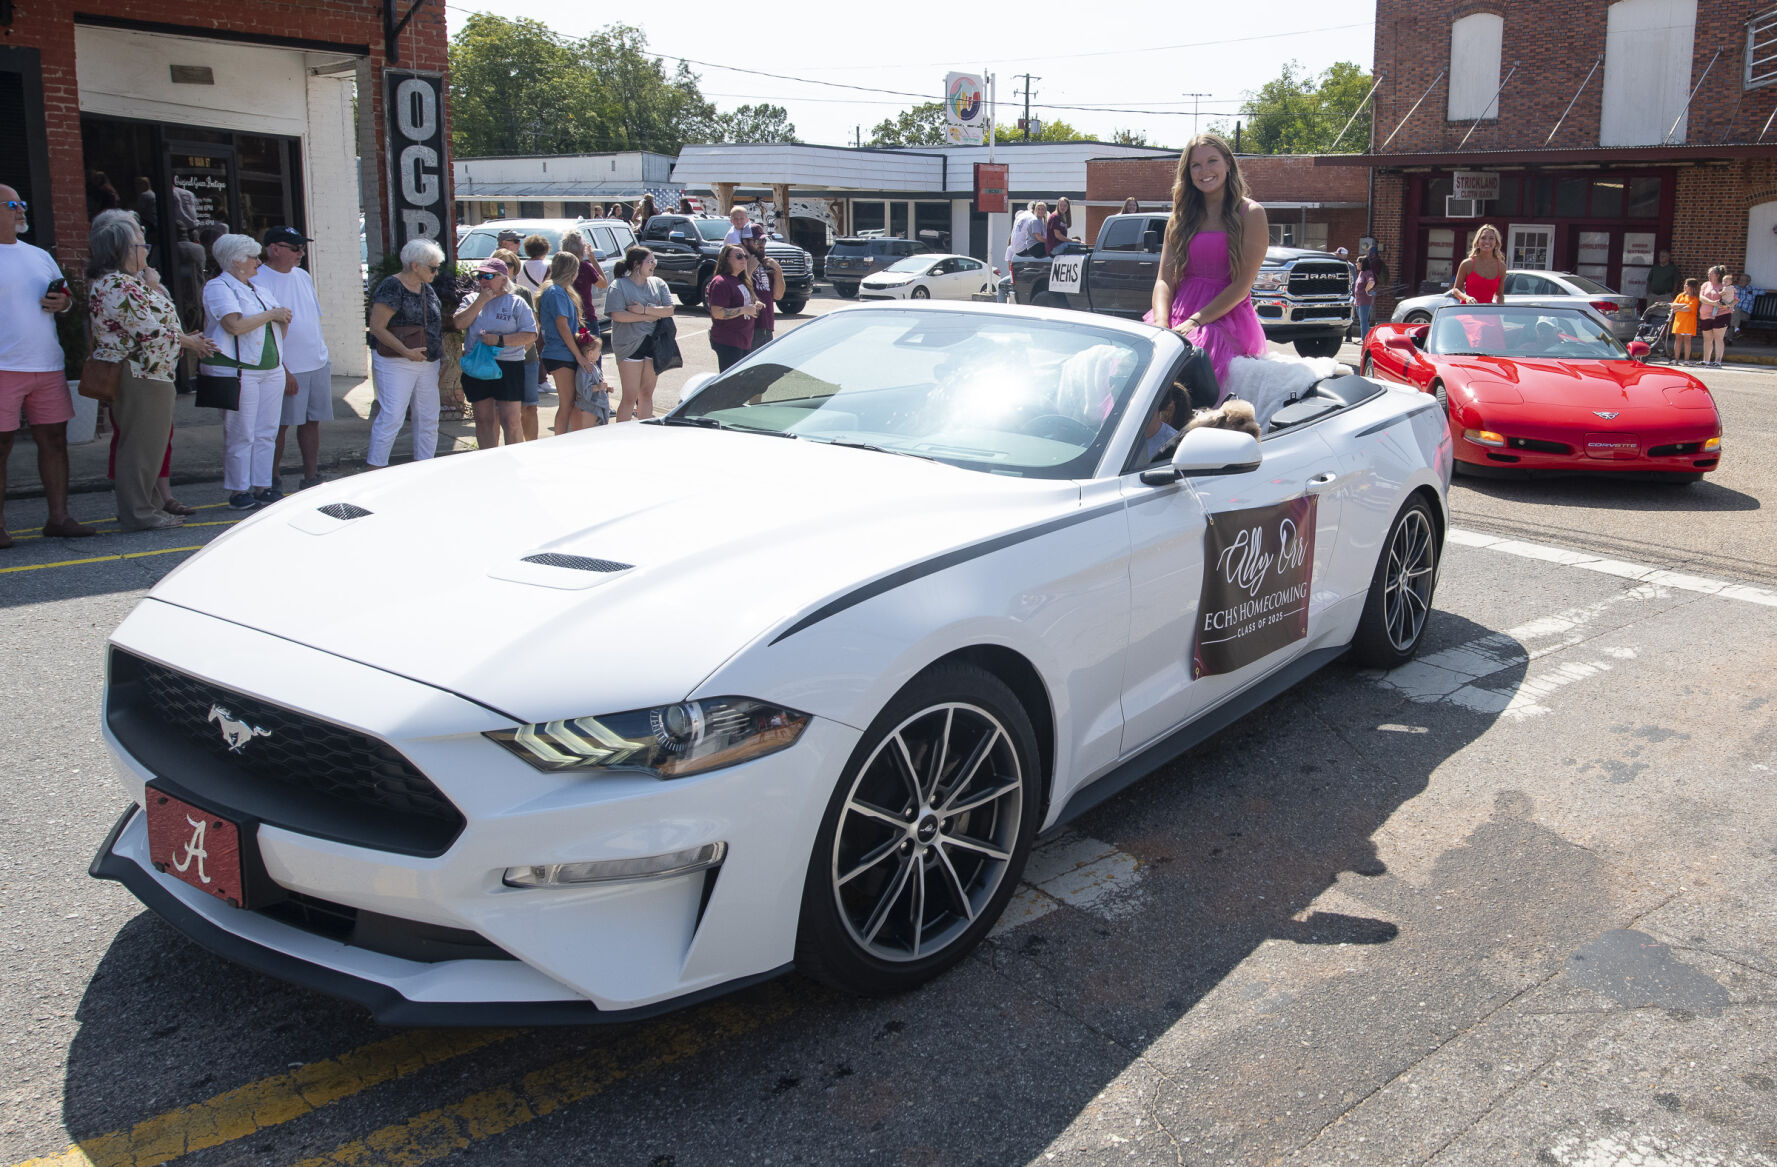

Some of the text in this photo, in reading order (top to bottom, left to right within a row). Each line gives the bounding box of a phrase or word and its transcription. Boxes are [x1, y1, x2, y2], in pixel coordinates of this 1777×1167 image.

[1456, 176, 1497, 189] STRICKLAND
[1051, 263, 1078, 283] NEHS
[1216, 518, 1308, 597] Ally Orr
[1204, 582, 1308, 631] ECHS HOMECOMING
[1237, 612, 1284, 638] CLASS OF 2025
[172, 813, 211, 884] A
